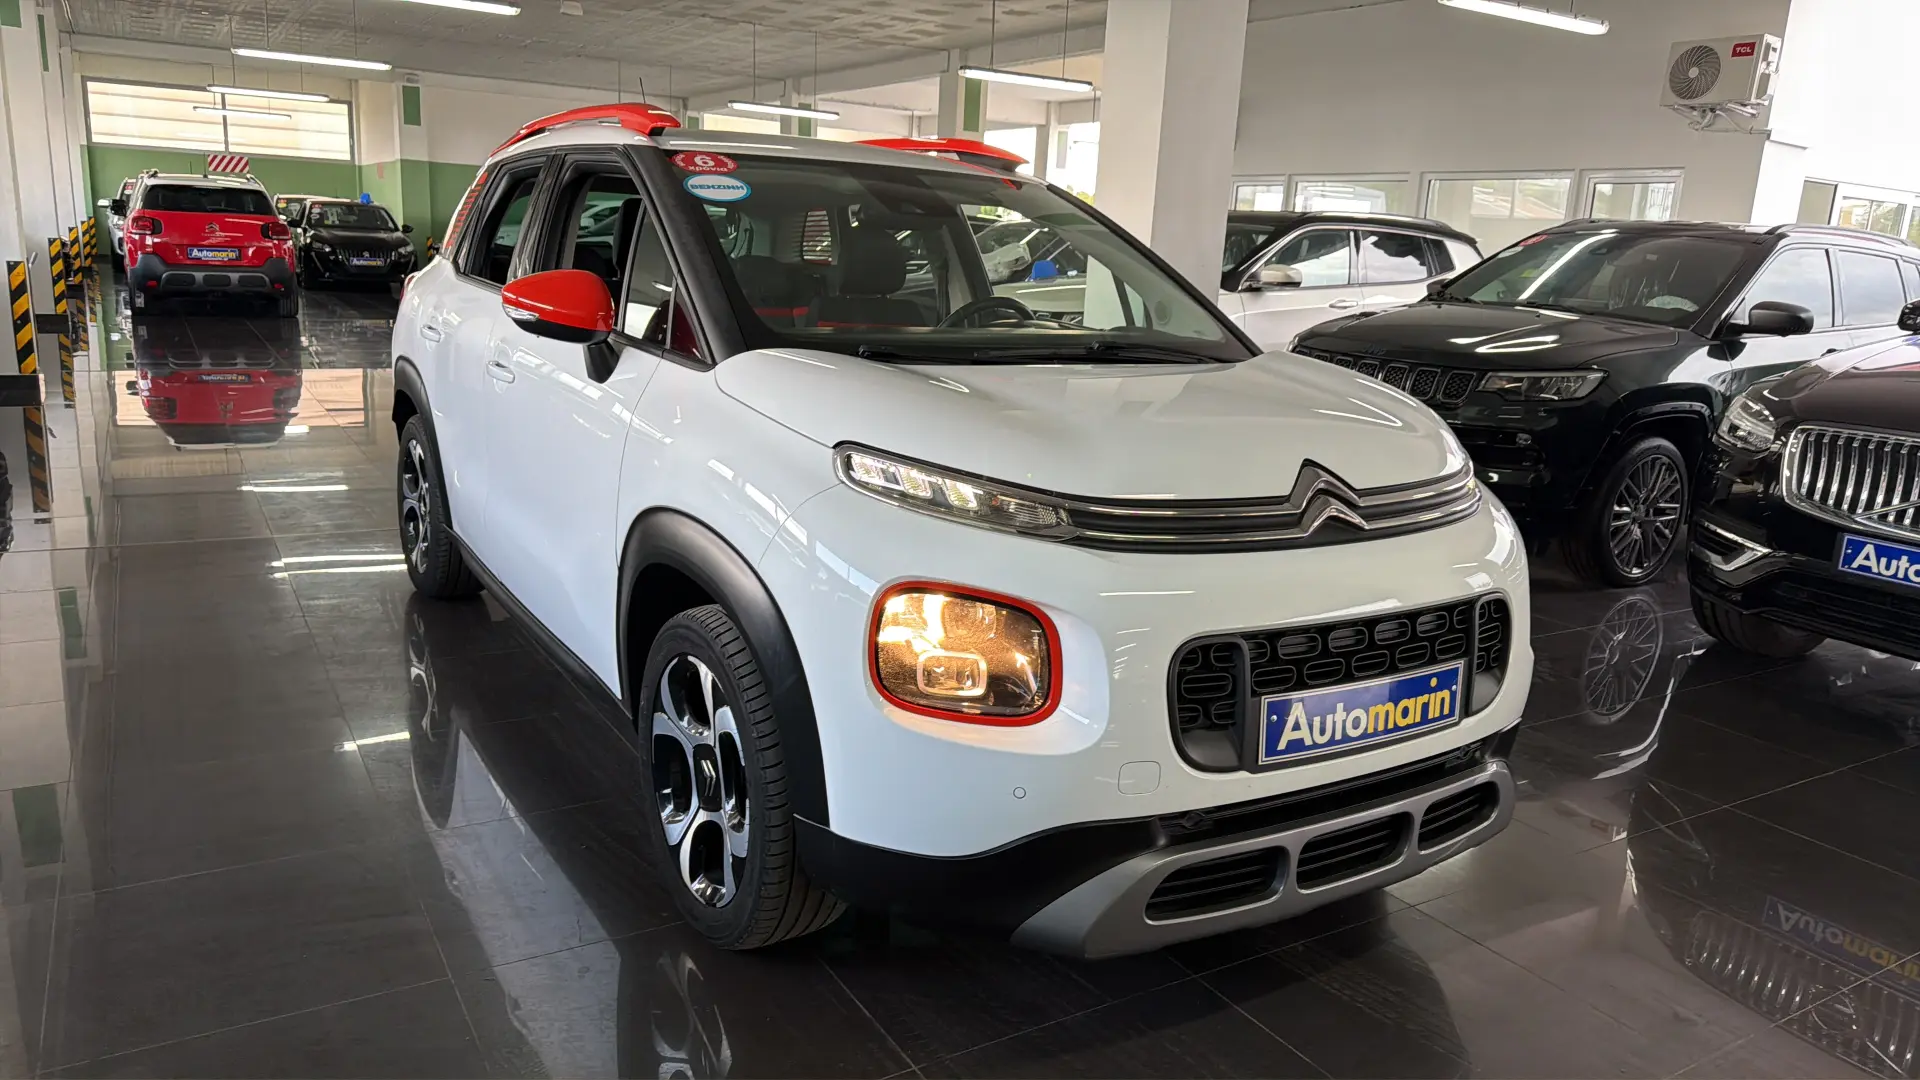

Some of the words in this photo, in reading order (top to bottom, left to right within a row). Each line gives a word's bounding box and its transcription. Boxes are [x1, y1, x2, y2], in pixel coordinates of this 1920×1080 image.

[694, 155, 715, 167] 6
[191, 248, 236, 258] Automarin
[1277, 677, 1450, 750] Automarin
